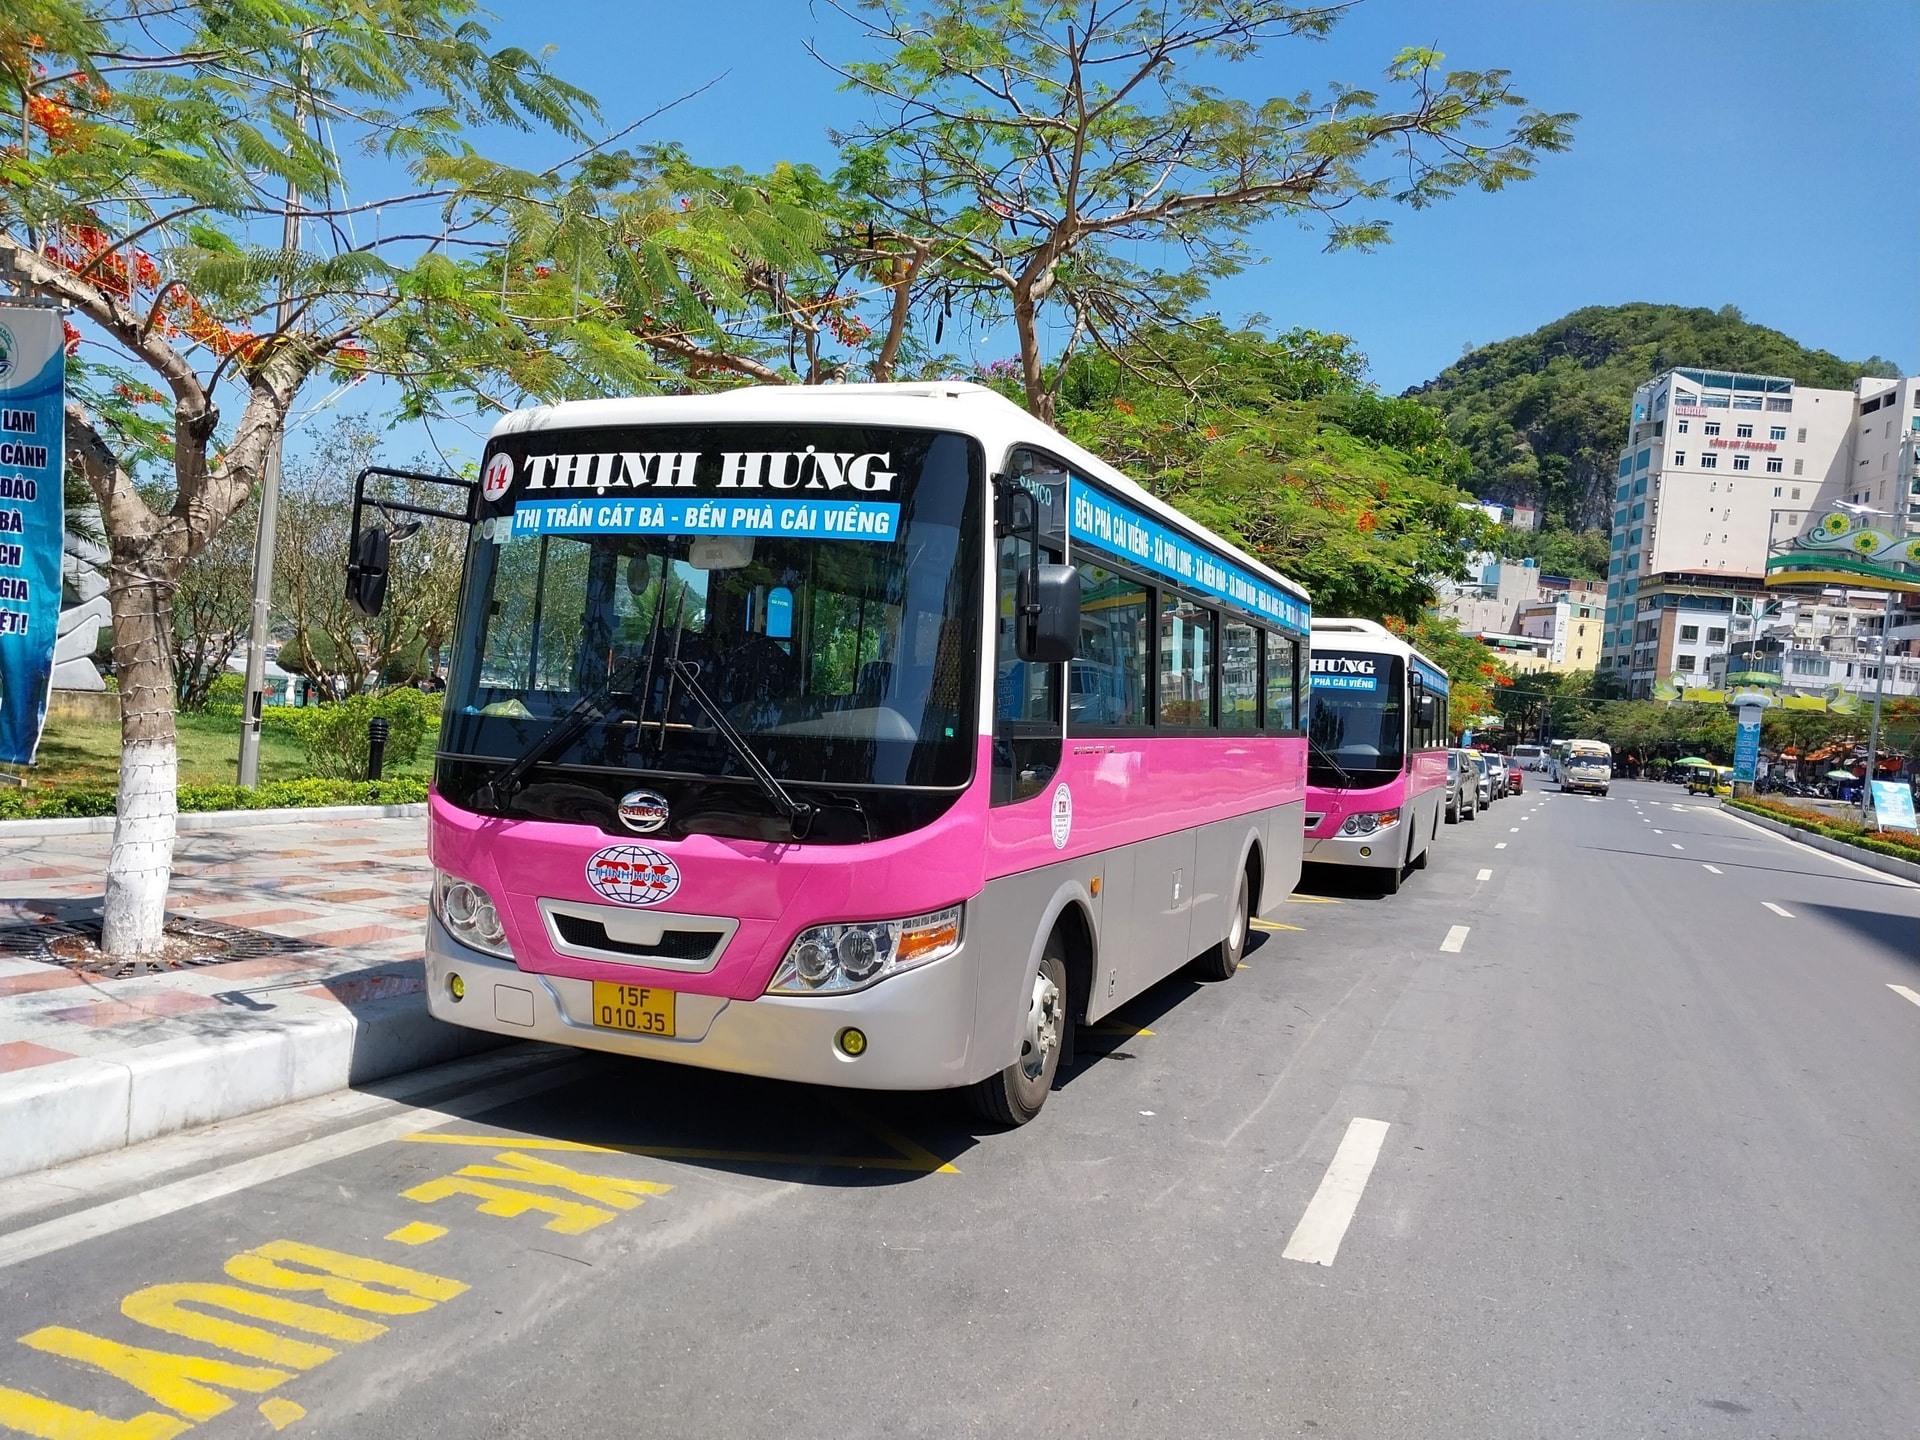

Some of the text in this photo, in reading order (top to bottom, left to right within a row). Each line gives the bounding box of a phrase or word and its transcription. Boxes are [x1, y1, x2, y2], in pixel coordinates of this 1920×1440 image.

[3, 409, 36, 433] LAM
[0, 440, 47, 469] CẢNH
[485, 464, 508, 491] 14
[524, 445, 897, 495] THỊNH HƯNG
[0, 474, 36, 501] ĐẢO
[0, 508, 23, 533] BÀ
[515, 509, 541, 532] THỊ
[547, 501, 593, 527] TRẤN
[598, 502, 634, 527] CÁT
[638, 503, 665, 528] BÀ
[685, 501, 727, 528] BẾN
[732, 505, 773, 530] PHÀ
[780, 505, 817, 531] CÁI
[824, 504, 890, 534] VIỀNG
[1075, 490, 1093, 534] BẾN
[1095, 506, 1112, 542] PHÀ
[1113, 513, 1126, 548] CÁI
[0, 577, 28, 601] GIA
[1310, 657, 1376, 674] HƯNG
[621, 805, 664, 818] SAMCO
[618, 985, 651, 1008] 15F
[601, 1005, 665, 1032] 010.35
